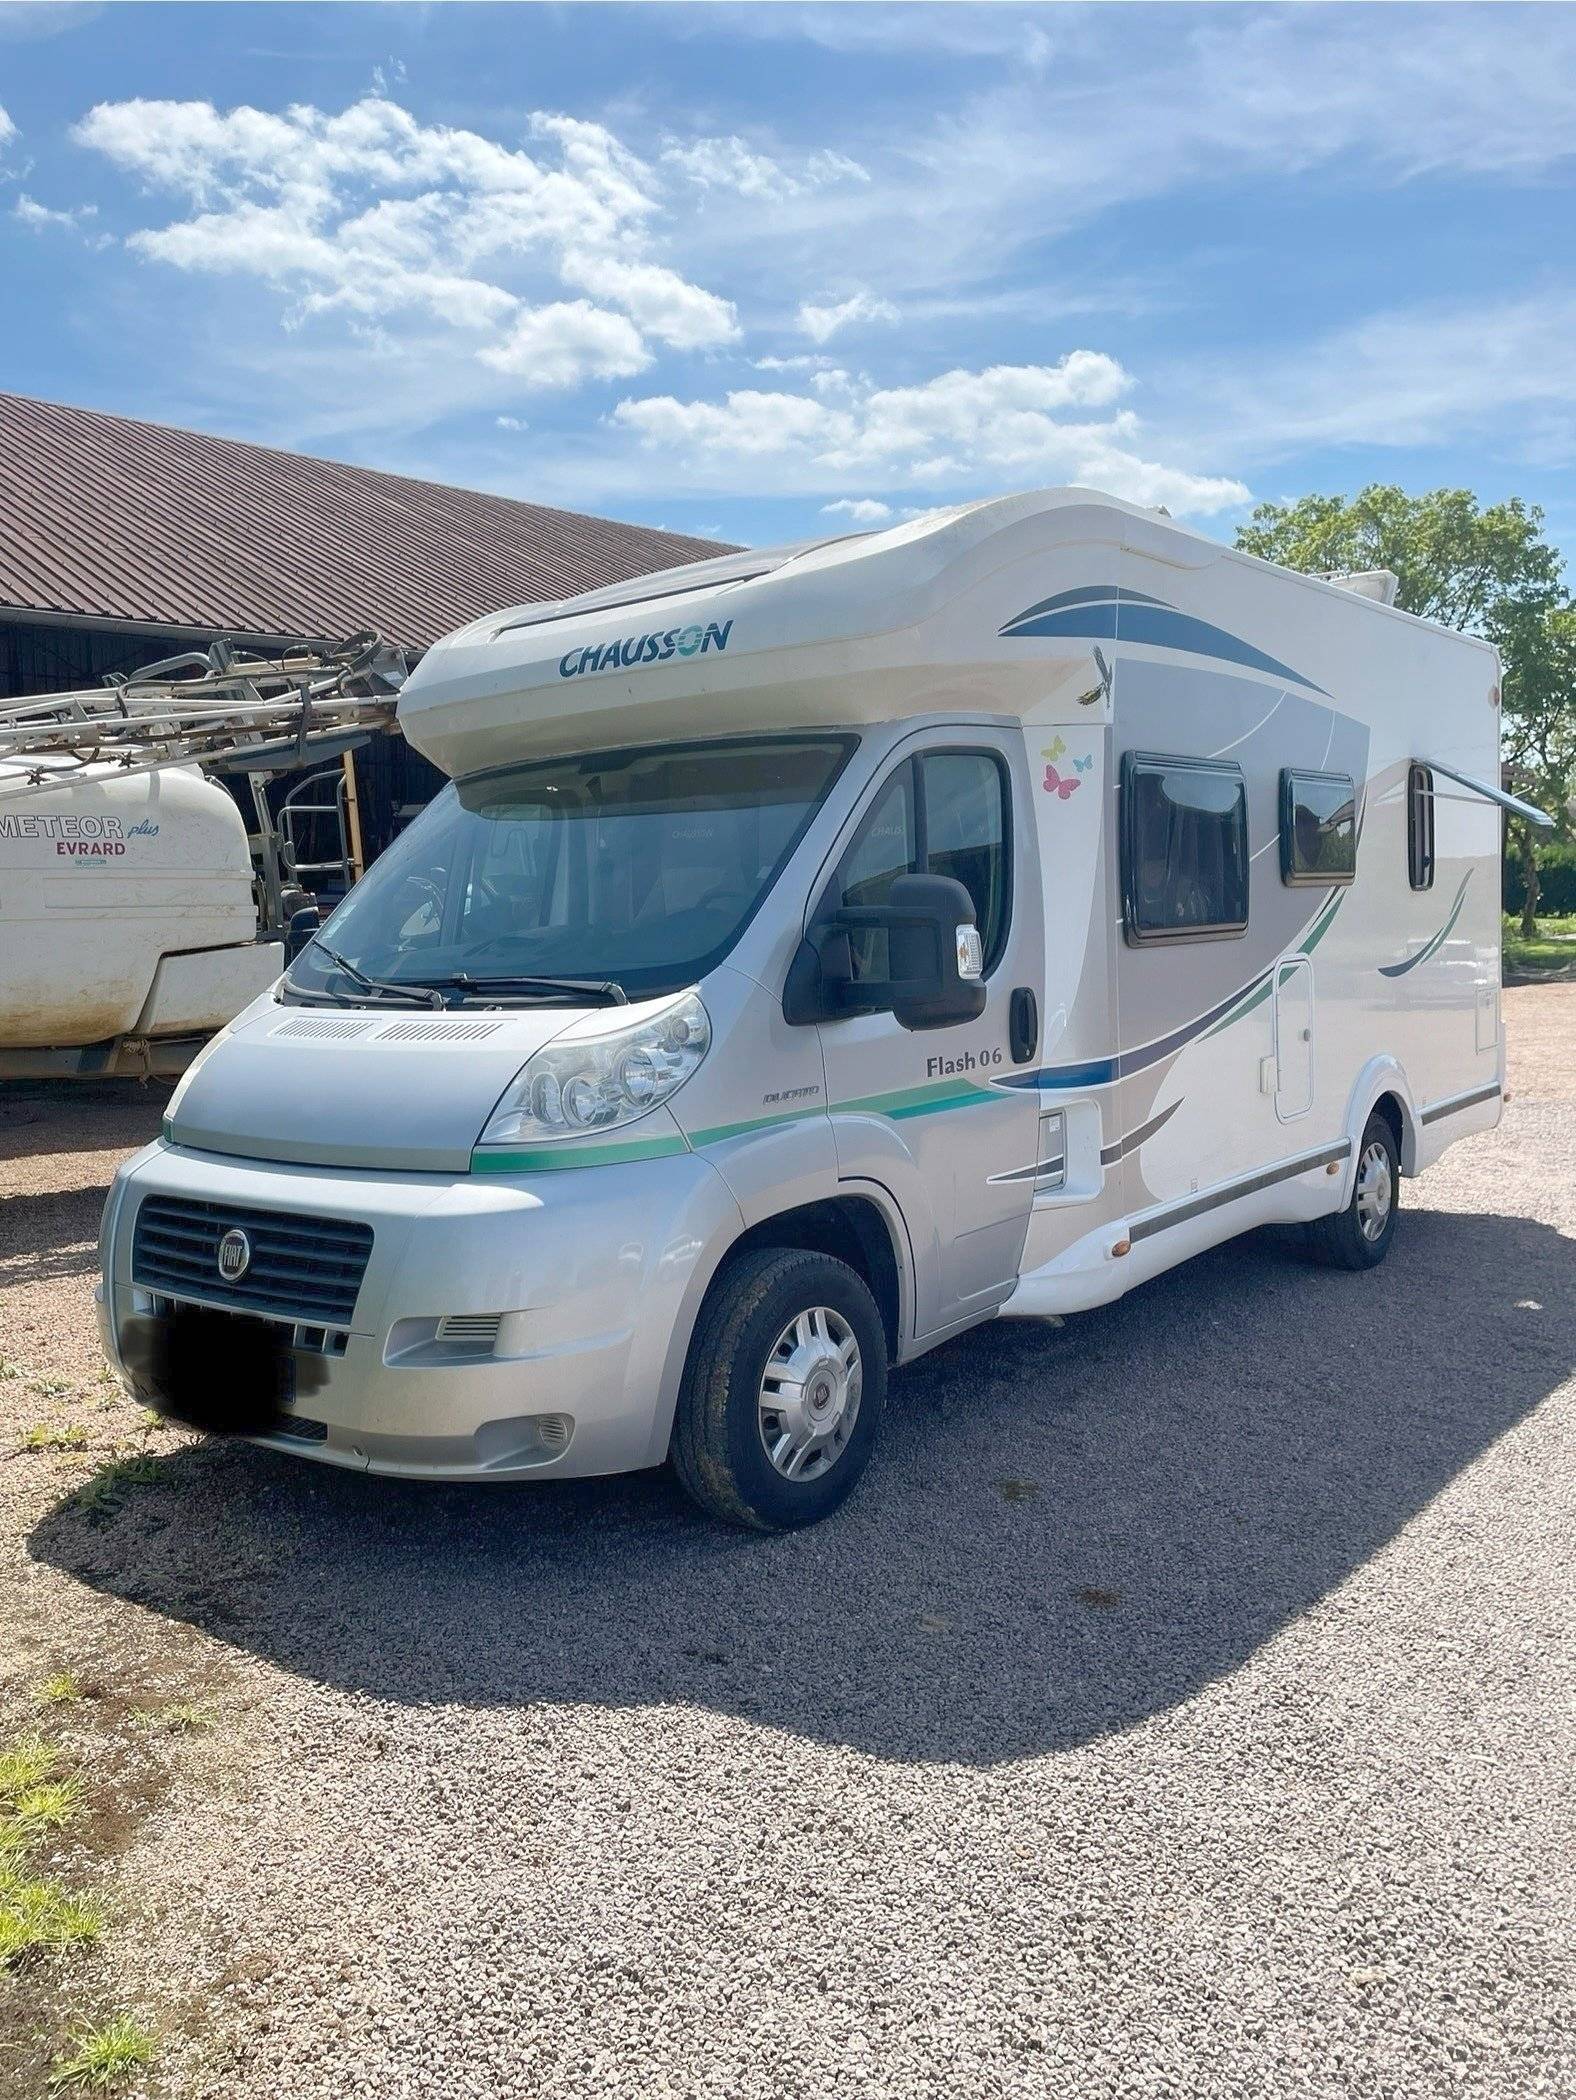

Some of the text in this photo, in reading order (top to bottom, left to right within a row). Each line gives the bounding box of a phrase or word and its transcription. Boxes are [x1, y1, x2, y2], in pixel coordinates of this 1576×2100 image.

[559, 620, 734, 678] CHAUSSON
[0, 815, 160, 838] METEOR plus
[57, 842, 126, 856] EVRARD
[926, 1047, 1003, 1077] Flash 06
[223, 1244, 243, 1267] FIAT
